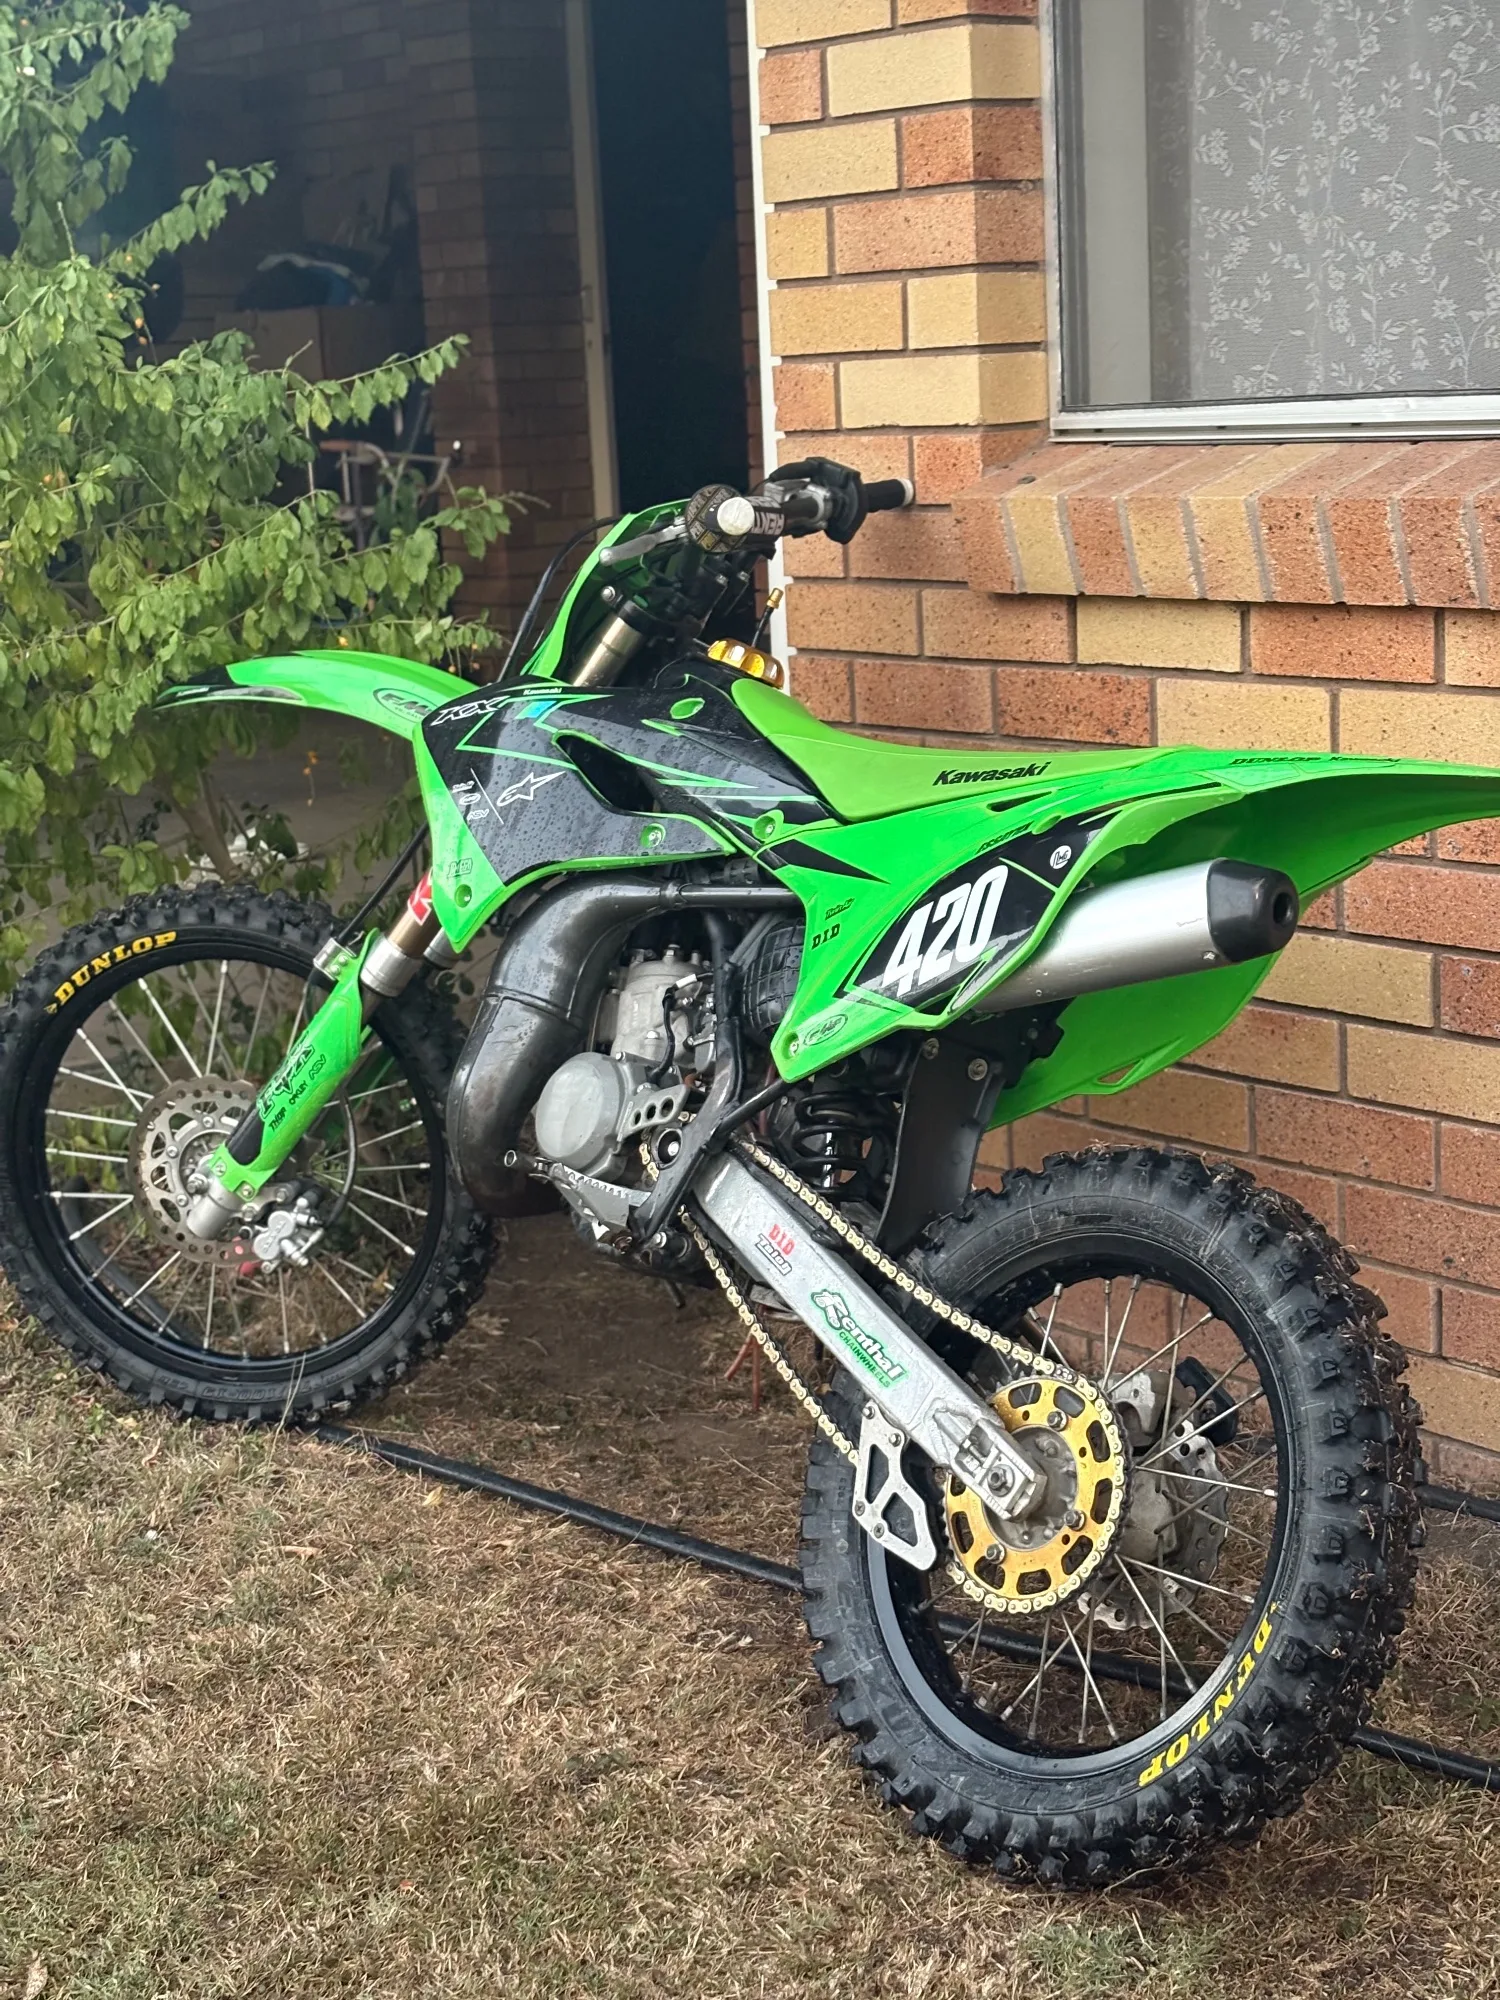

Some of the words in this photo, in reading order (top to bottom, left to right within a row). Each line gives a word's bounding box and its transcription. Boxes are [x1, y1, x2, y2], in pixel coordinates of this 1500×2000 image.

[381, 692, 433, 716] FM
[932, 761, 1052, 787] Kawasaki
[881, 864, 1009, 998] 420
[54, 931, 177, 1006] DUNLOP
[755, 1233, 793, 1276] Talon
[811, 1288, 907, 1382] Renthal
[838, 1330, 891, 1389] CHAINWHEELS
[1138, 1613, 1273, 1787] DUNLOP
